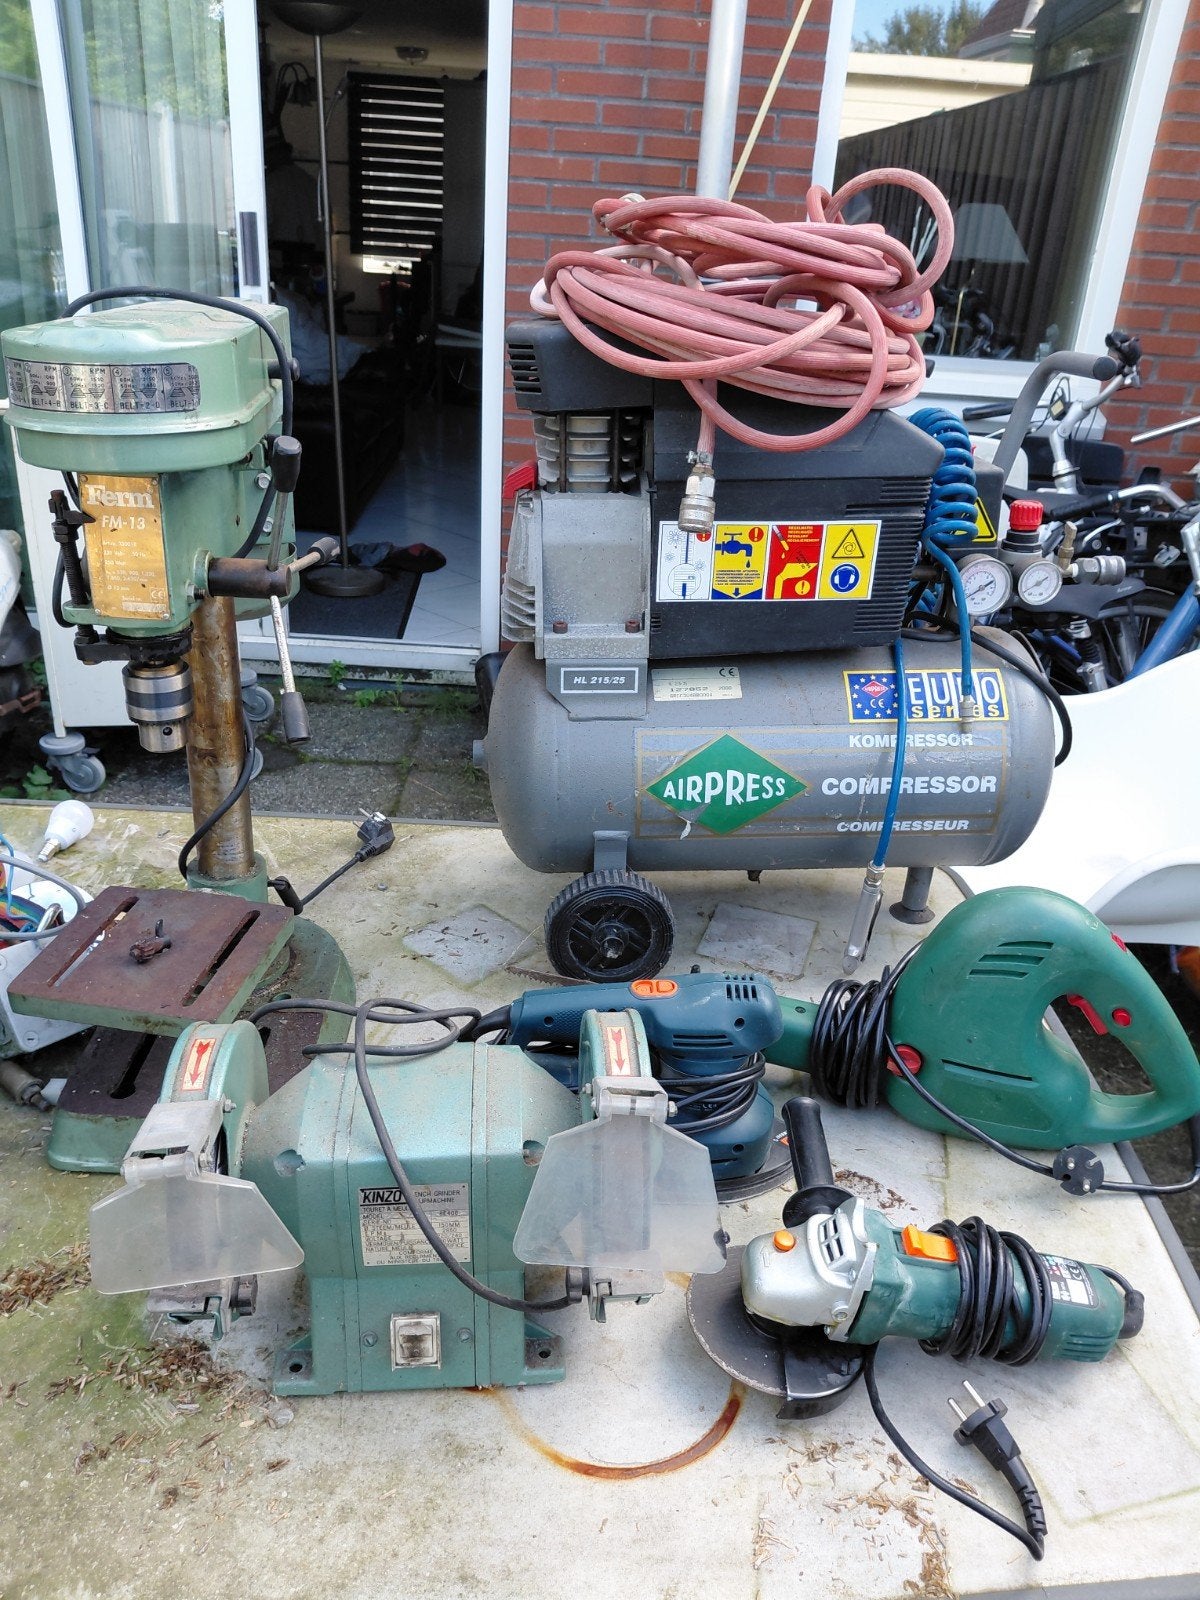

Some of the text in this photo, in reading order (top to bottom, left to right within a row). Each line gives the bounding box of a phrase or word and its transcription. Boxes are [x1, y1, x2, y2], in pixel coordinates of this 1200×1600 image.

[85, 484, 154, 509] Ferm
[102, 516, 146, 529] FM-13
[911, 705, 1000, 718] seres
[663, 770, 786, 806] AIRPRESS
[363, 1190, 402, 1204] KINZO
